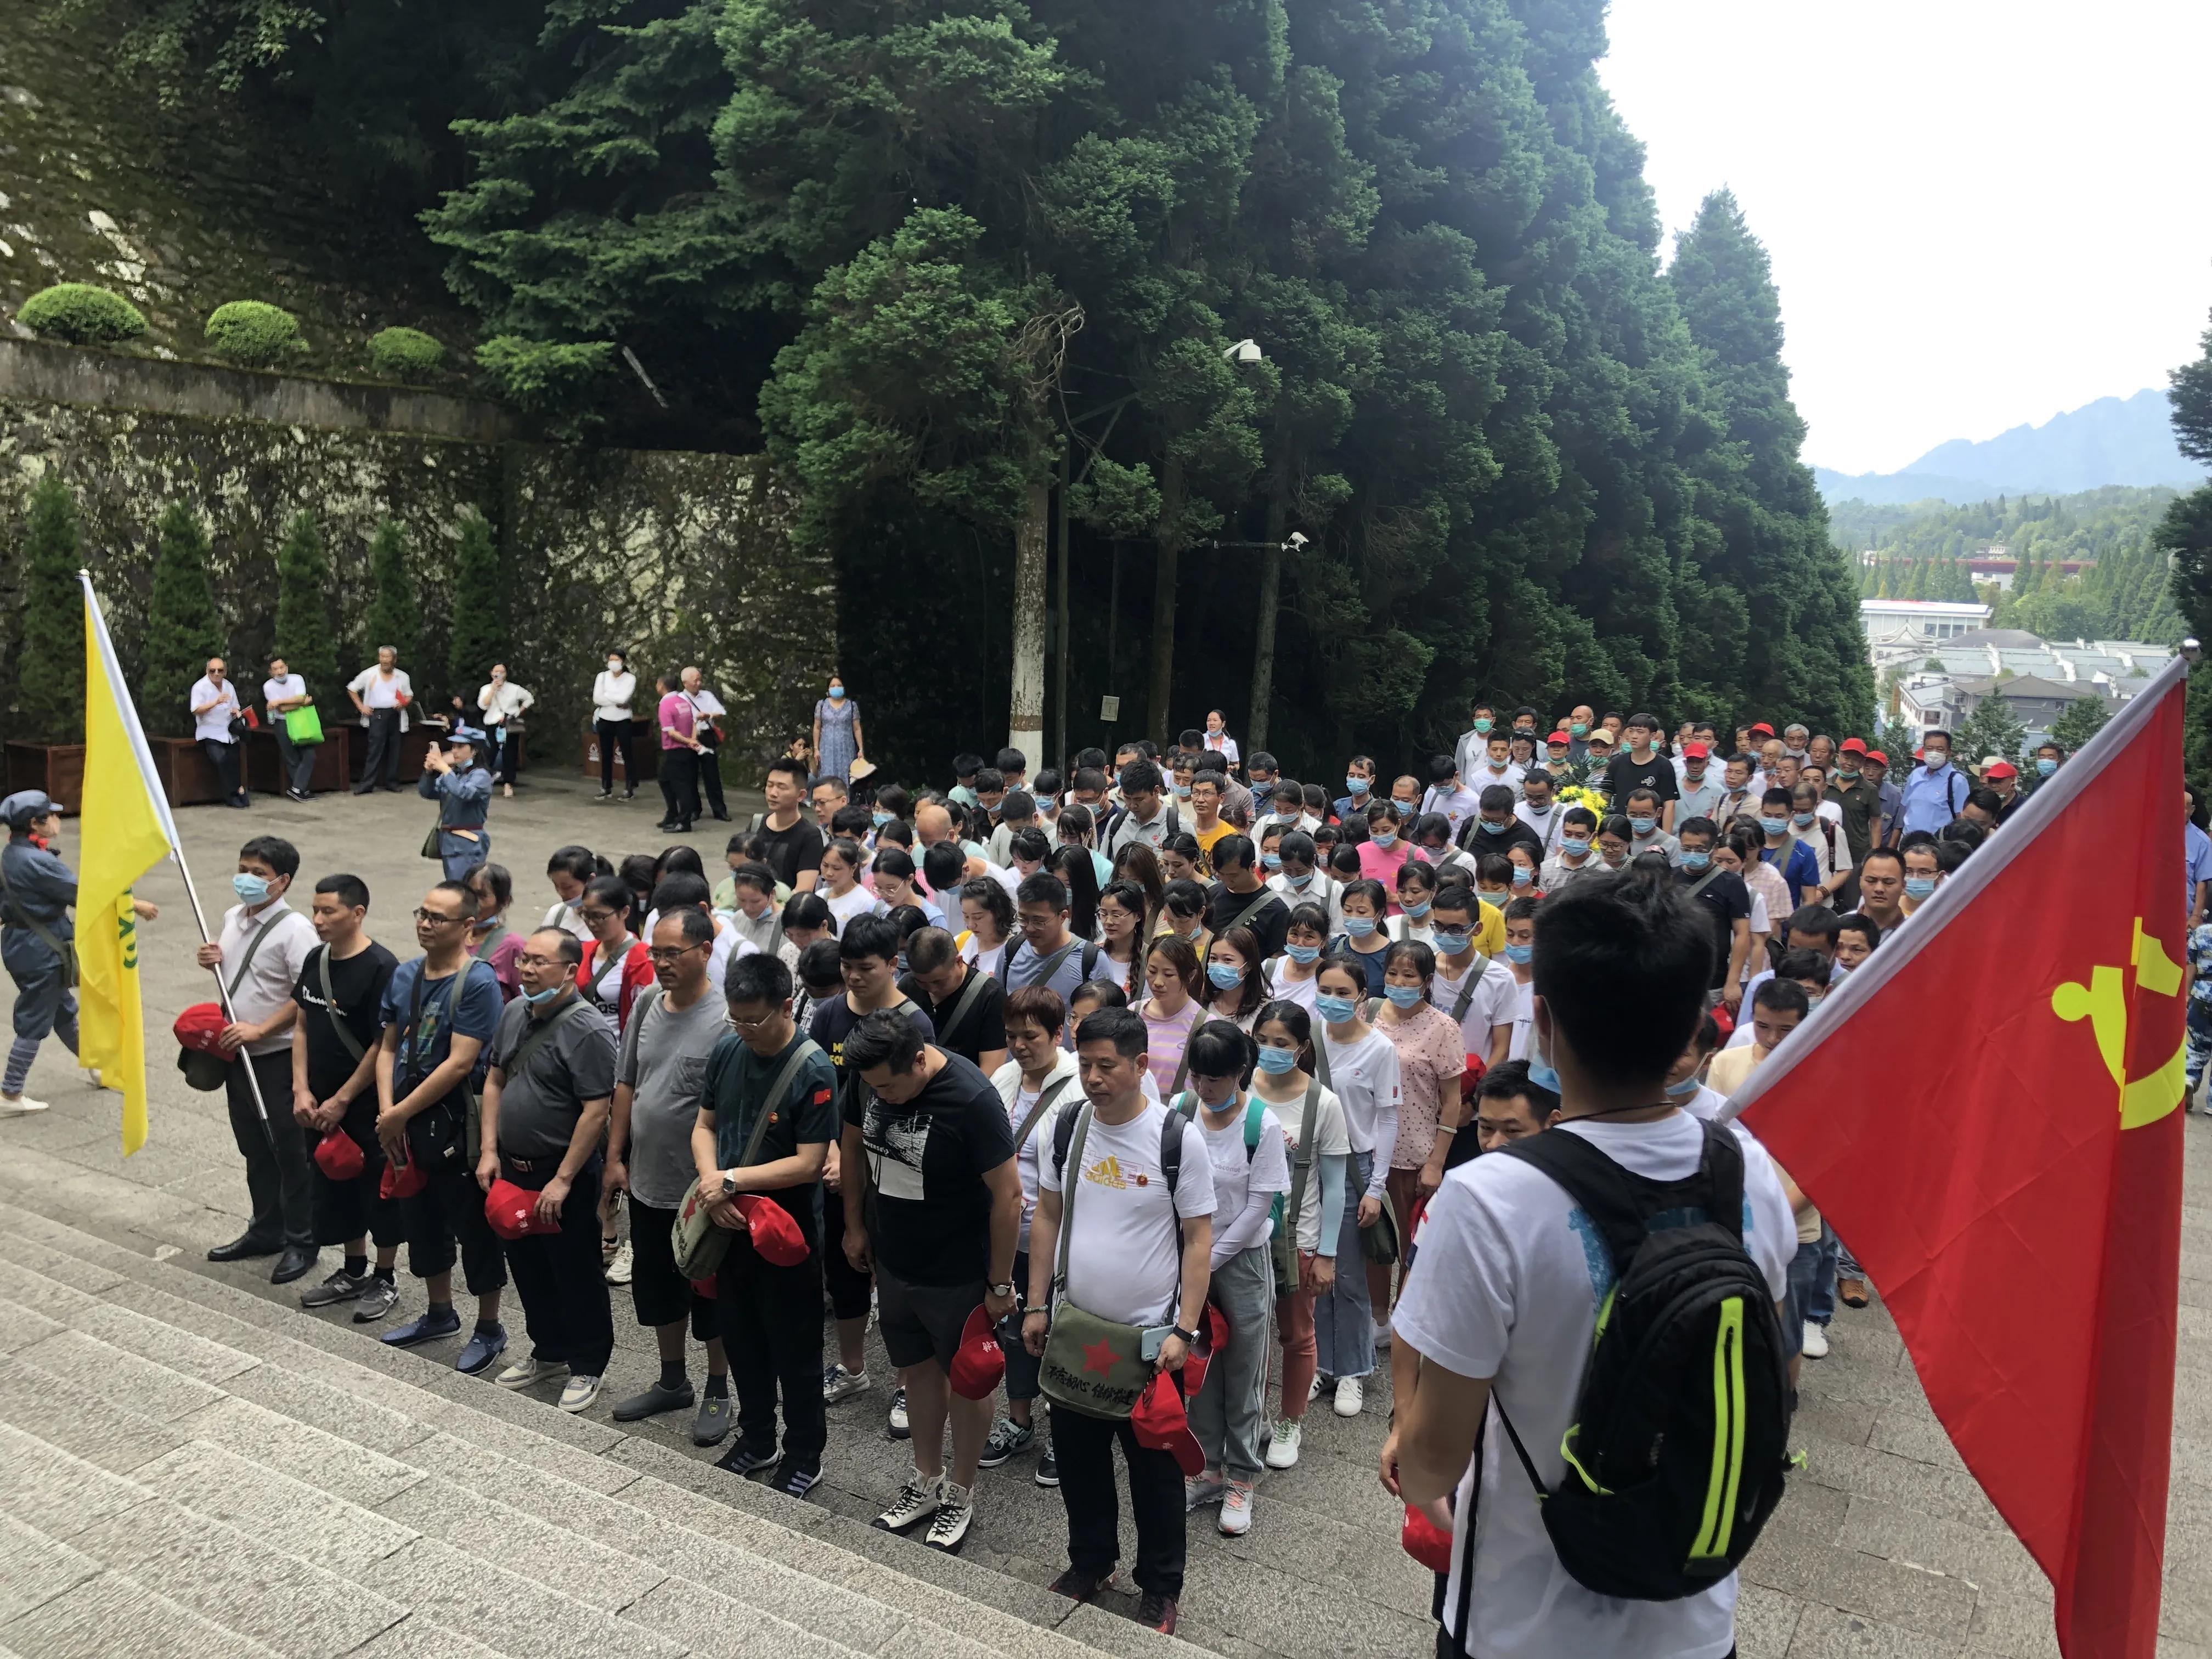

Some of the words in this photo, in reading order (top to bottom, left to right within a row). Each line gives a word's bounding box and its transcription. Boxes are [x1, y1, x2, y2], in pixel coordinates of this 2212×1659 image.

[862, 1137, 884, 1153] NVERSE
[1215, 1163, 1241, 1172] coconut
[1047, 1365, 1091, 1392] 不忘初心
